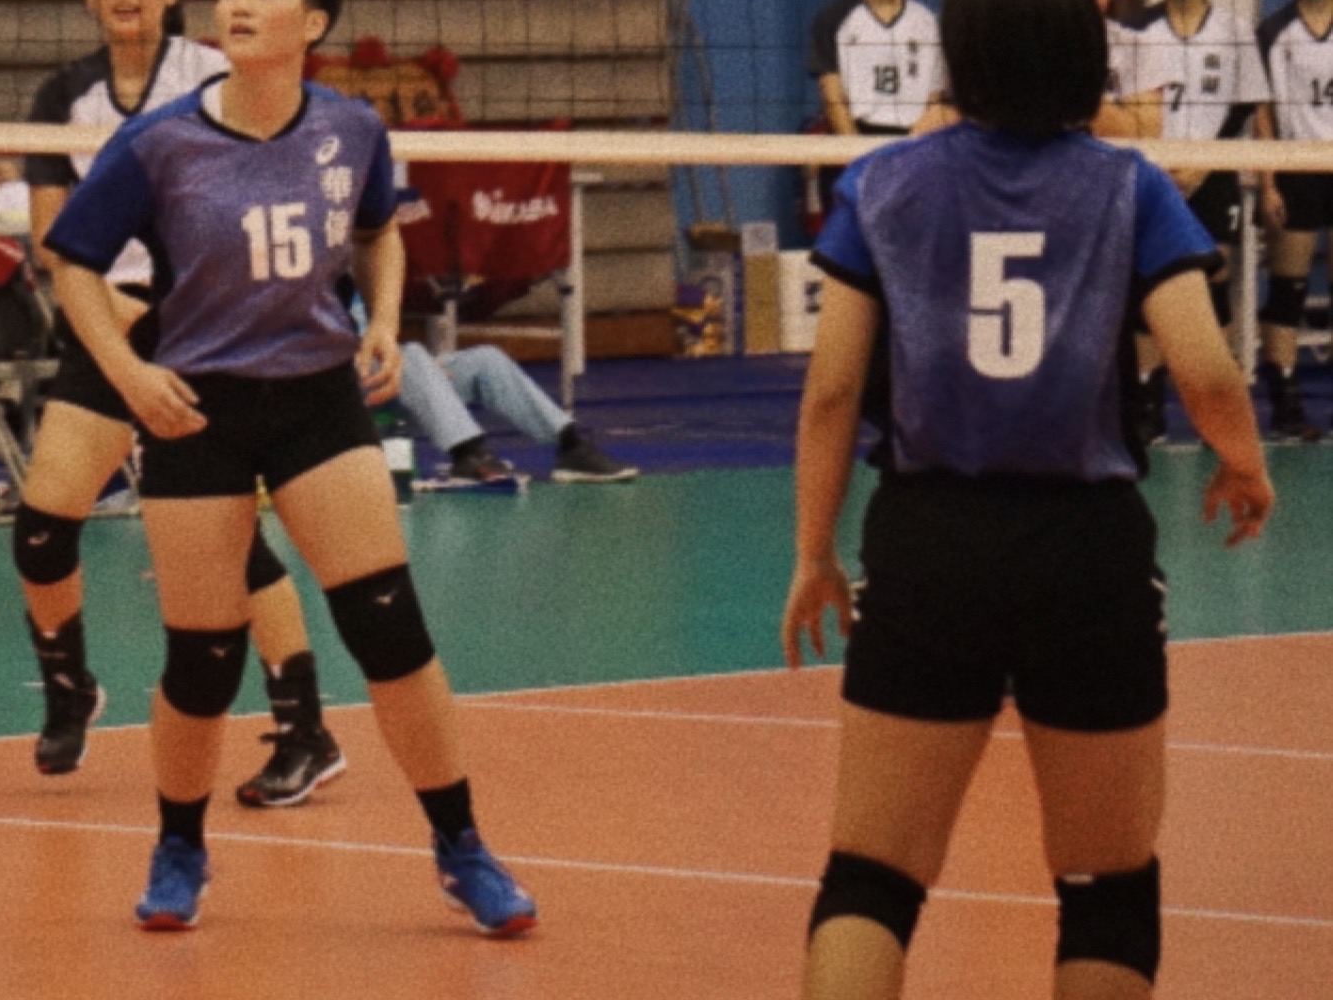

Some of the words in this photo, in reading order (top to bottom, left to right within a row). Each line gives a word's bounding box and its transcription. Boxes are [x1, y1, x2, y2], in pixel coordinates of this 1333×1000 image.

[873, 65, 900, 95] 18
[241, 202, 313, 281] 15
[968, 231, 1045, 379] 5
